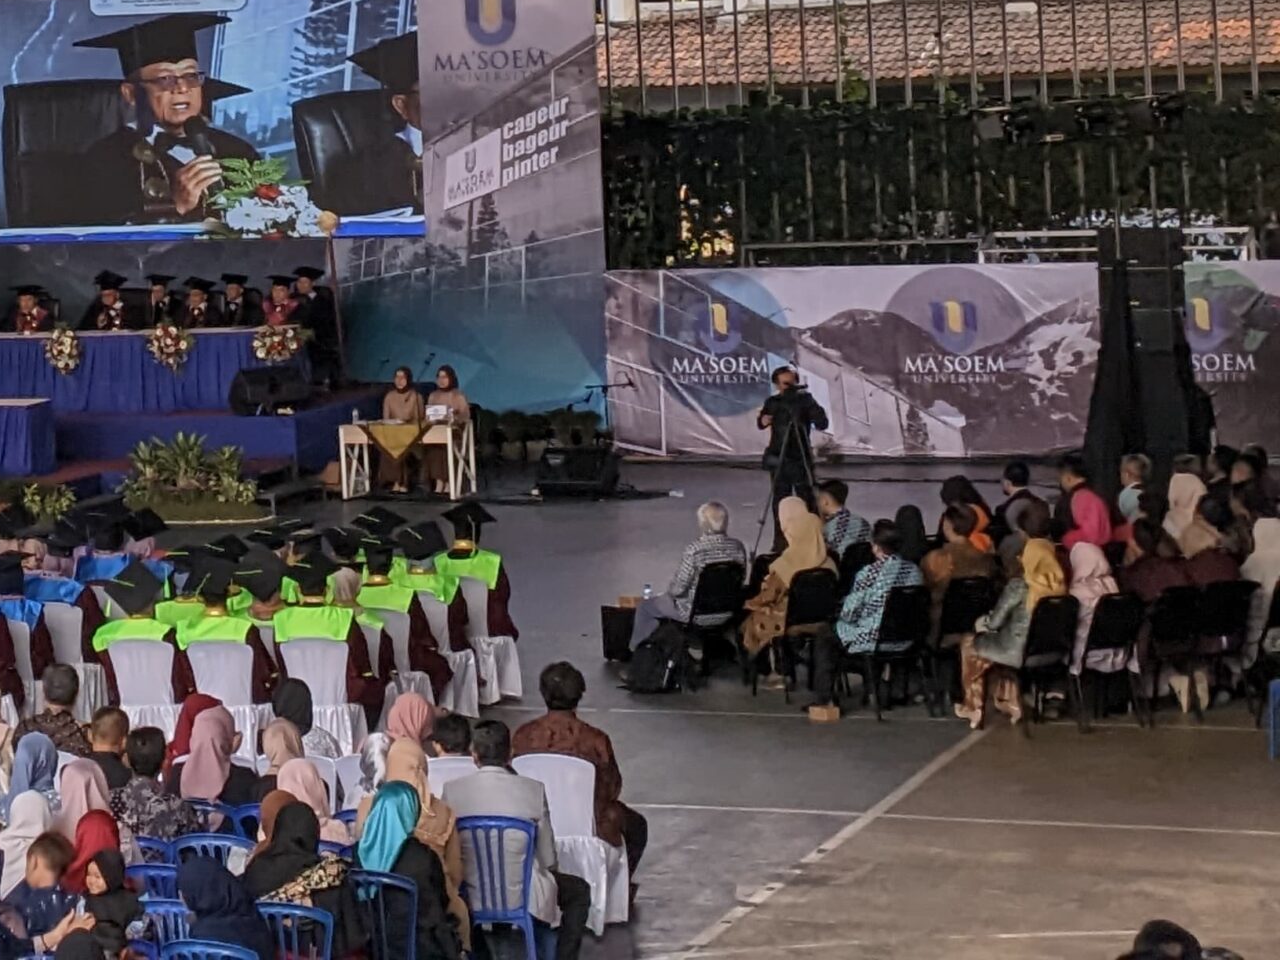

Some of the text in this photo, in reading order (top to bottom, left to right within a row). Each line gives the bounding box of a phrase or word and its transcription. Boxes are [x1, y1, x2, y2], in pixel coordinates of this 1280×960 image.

[434, 47, 546, 72] MA'SOEM
[502, 96, 569, 140] cageur
[502, 119, 570, 162] bageur
[502, 145, 559, 187] pinter
[672, 356, 767, 374] MA'SOEM
[904, 355, 1005, 373] MA'SOEM
